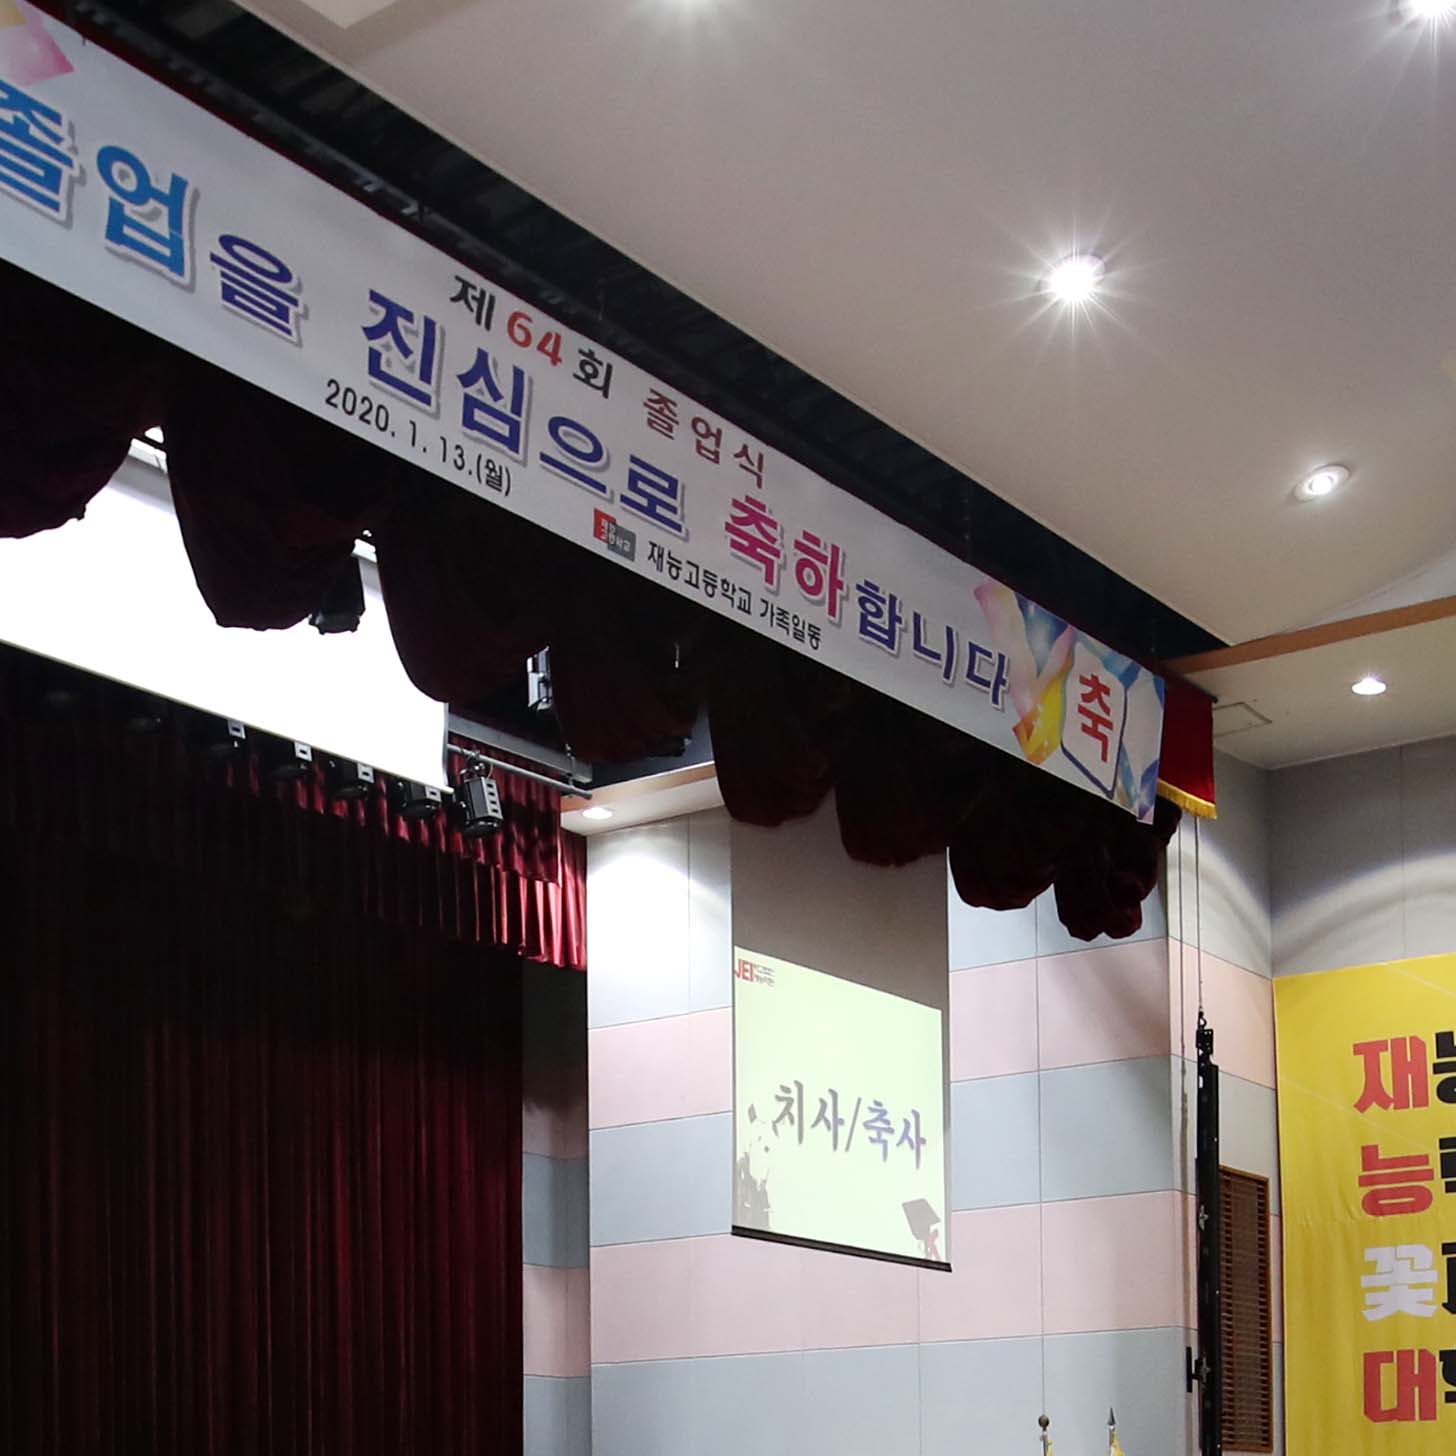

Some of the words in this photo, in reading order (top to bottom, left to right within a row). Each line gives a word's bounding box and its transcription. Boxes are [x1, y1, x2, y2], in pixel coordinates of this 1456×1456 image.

[643, 388, 764, 488] 졸업식
[362, 289, 687, 533] 진심으로
[725, 495, 1007, 705] 축하합니다
[648, 541, 752, 615] 재능고등학교
[760, 598, 821, 650] 가족일동
[1078, 674, 1114, 763] 축
[774, 1080, 927, 1170] 치사/축사
